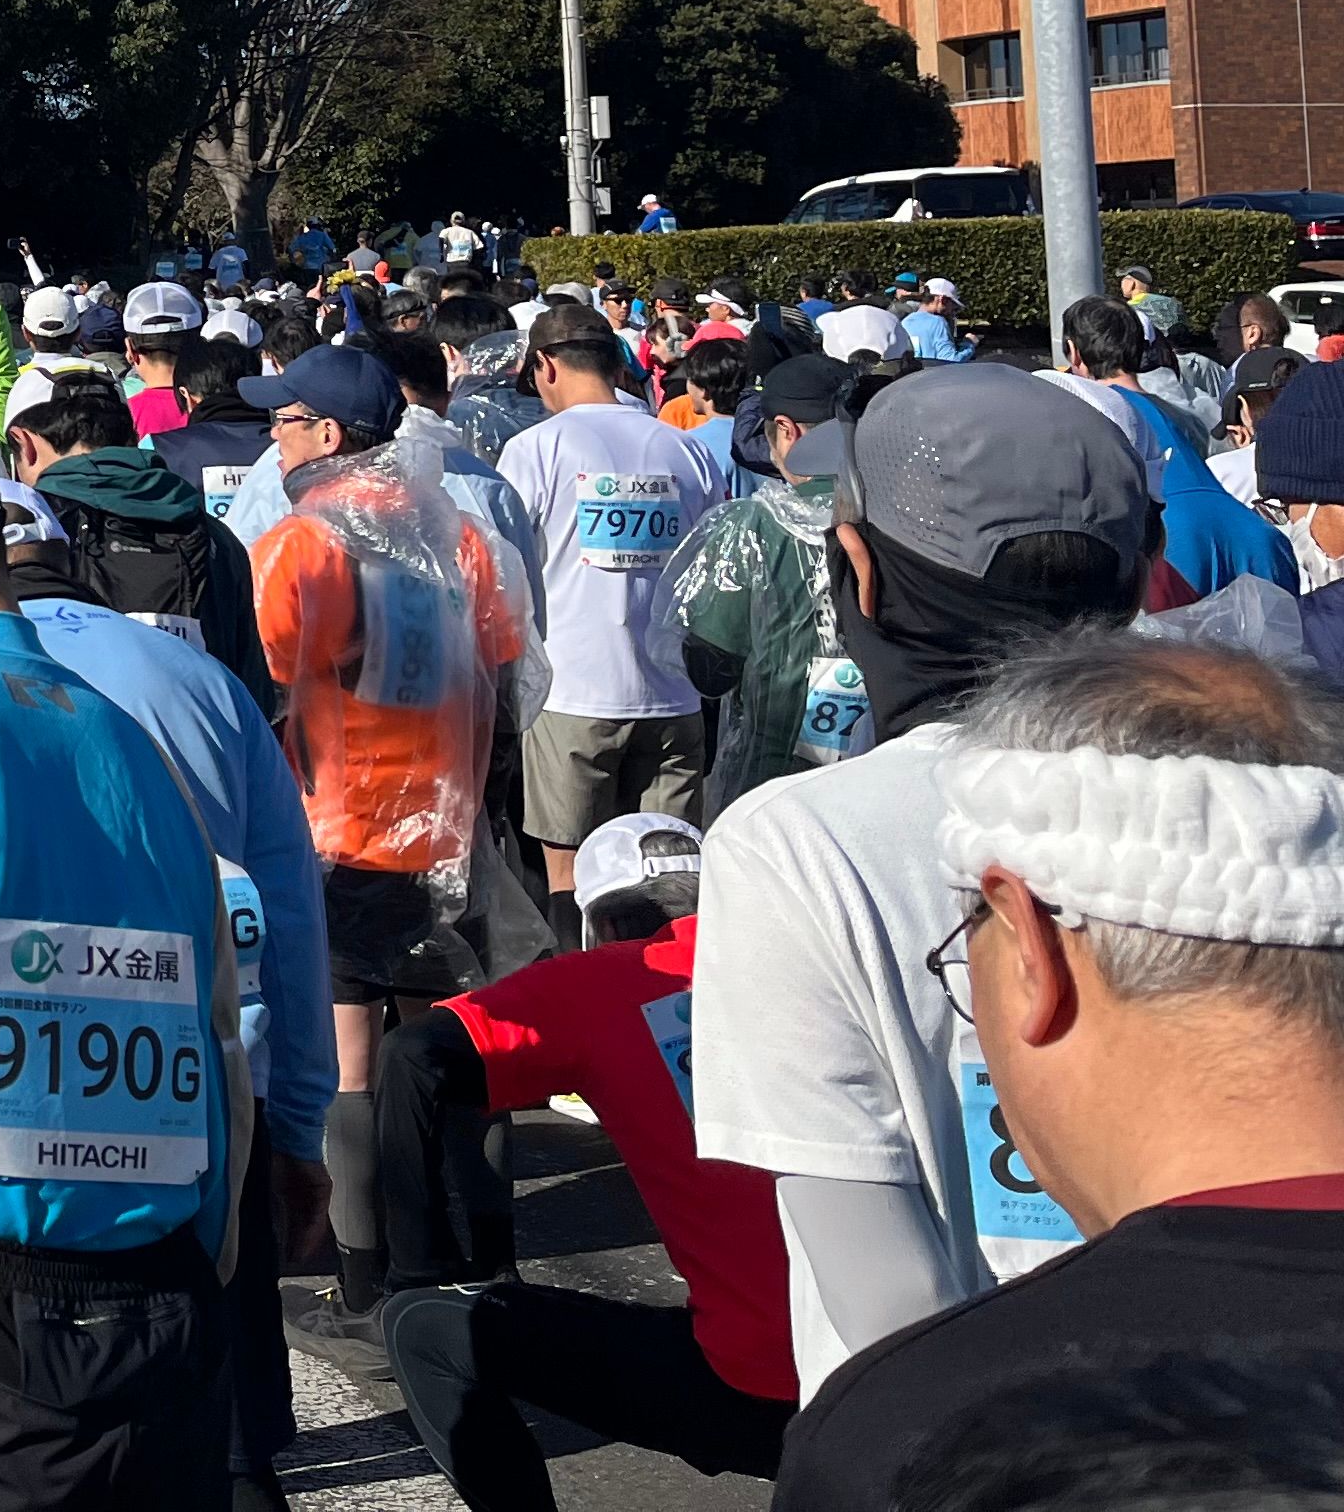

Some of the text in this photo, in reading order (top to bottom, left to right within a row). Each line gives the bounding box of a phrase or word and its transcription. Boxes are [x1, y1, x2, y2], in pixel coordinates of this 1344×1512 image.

[584, 508, 679, 538] 7970G
[612, 553, 660, 564] HITACHI
[230, 907, 260, 949] G
[77, 944, 180, 984] JX金属
[37, 1141, 148, 1170] HITACHI
